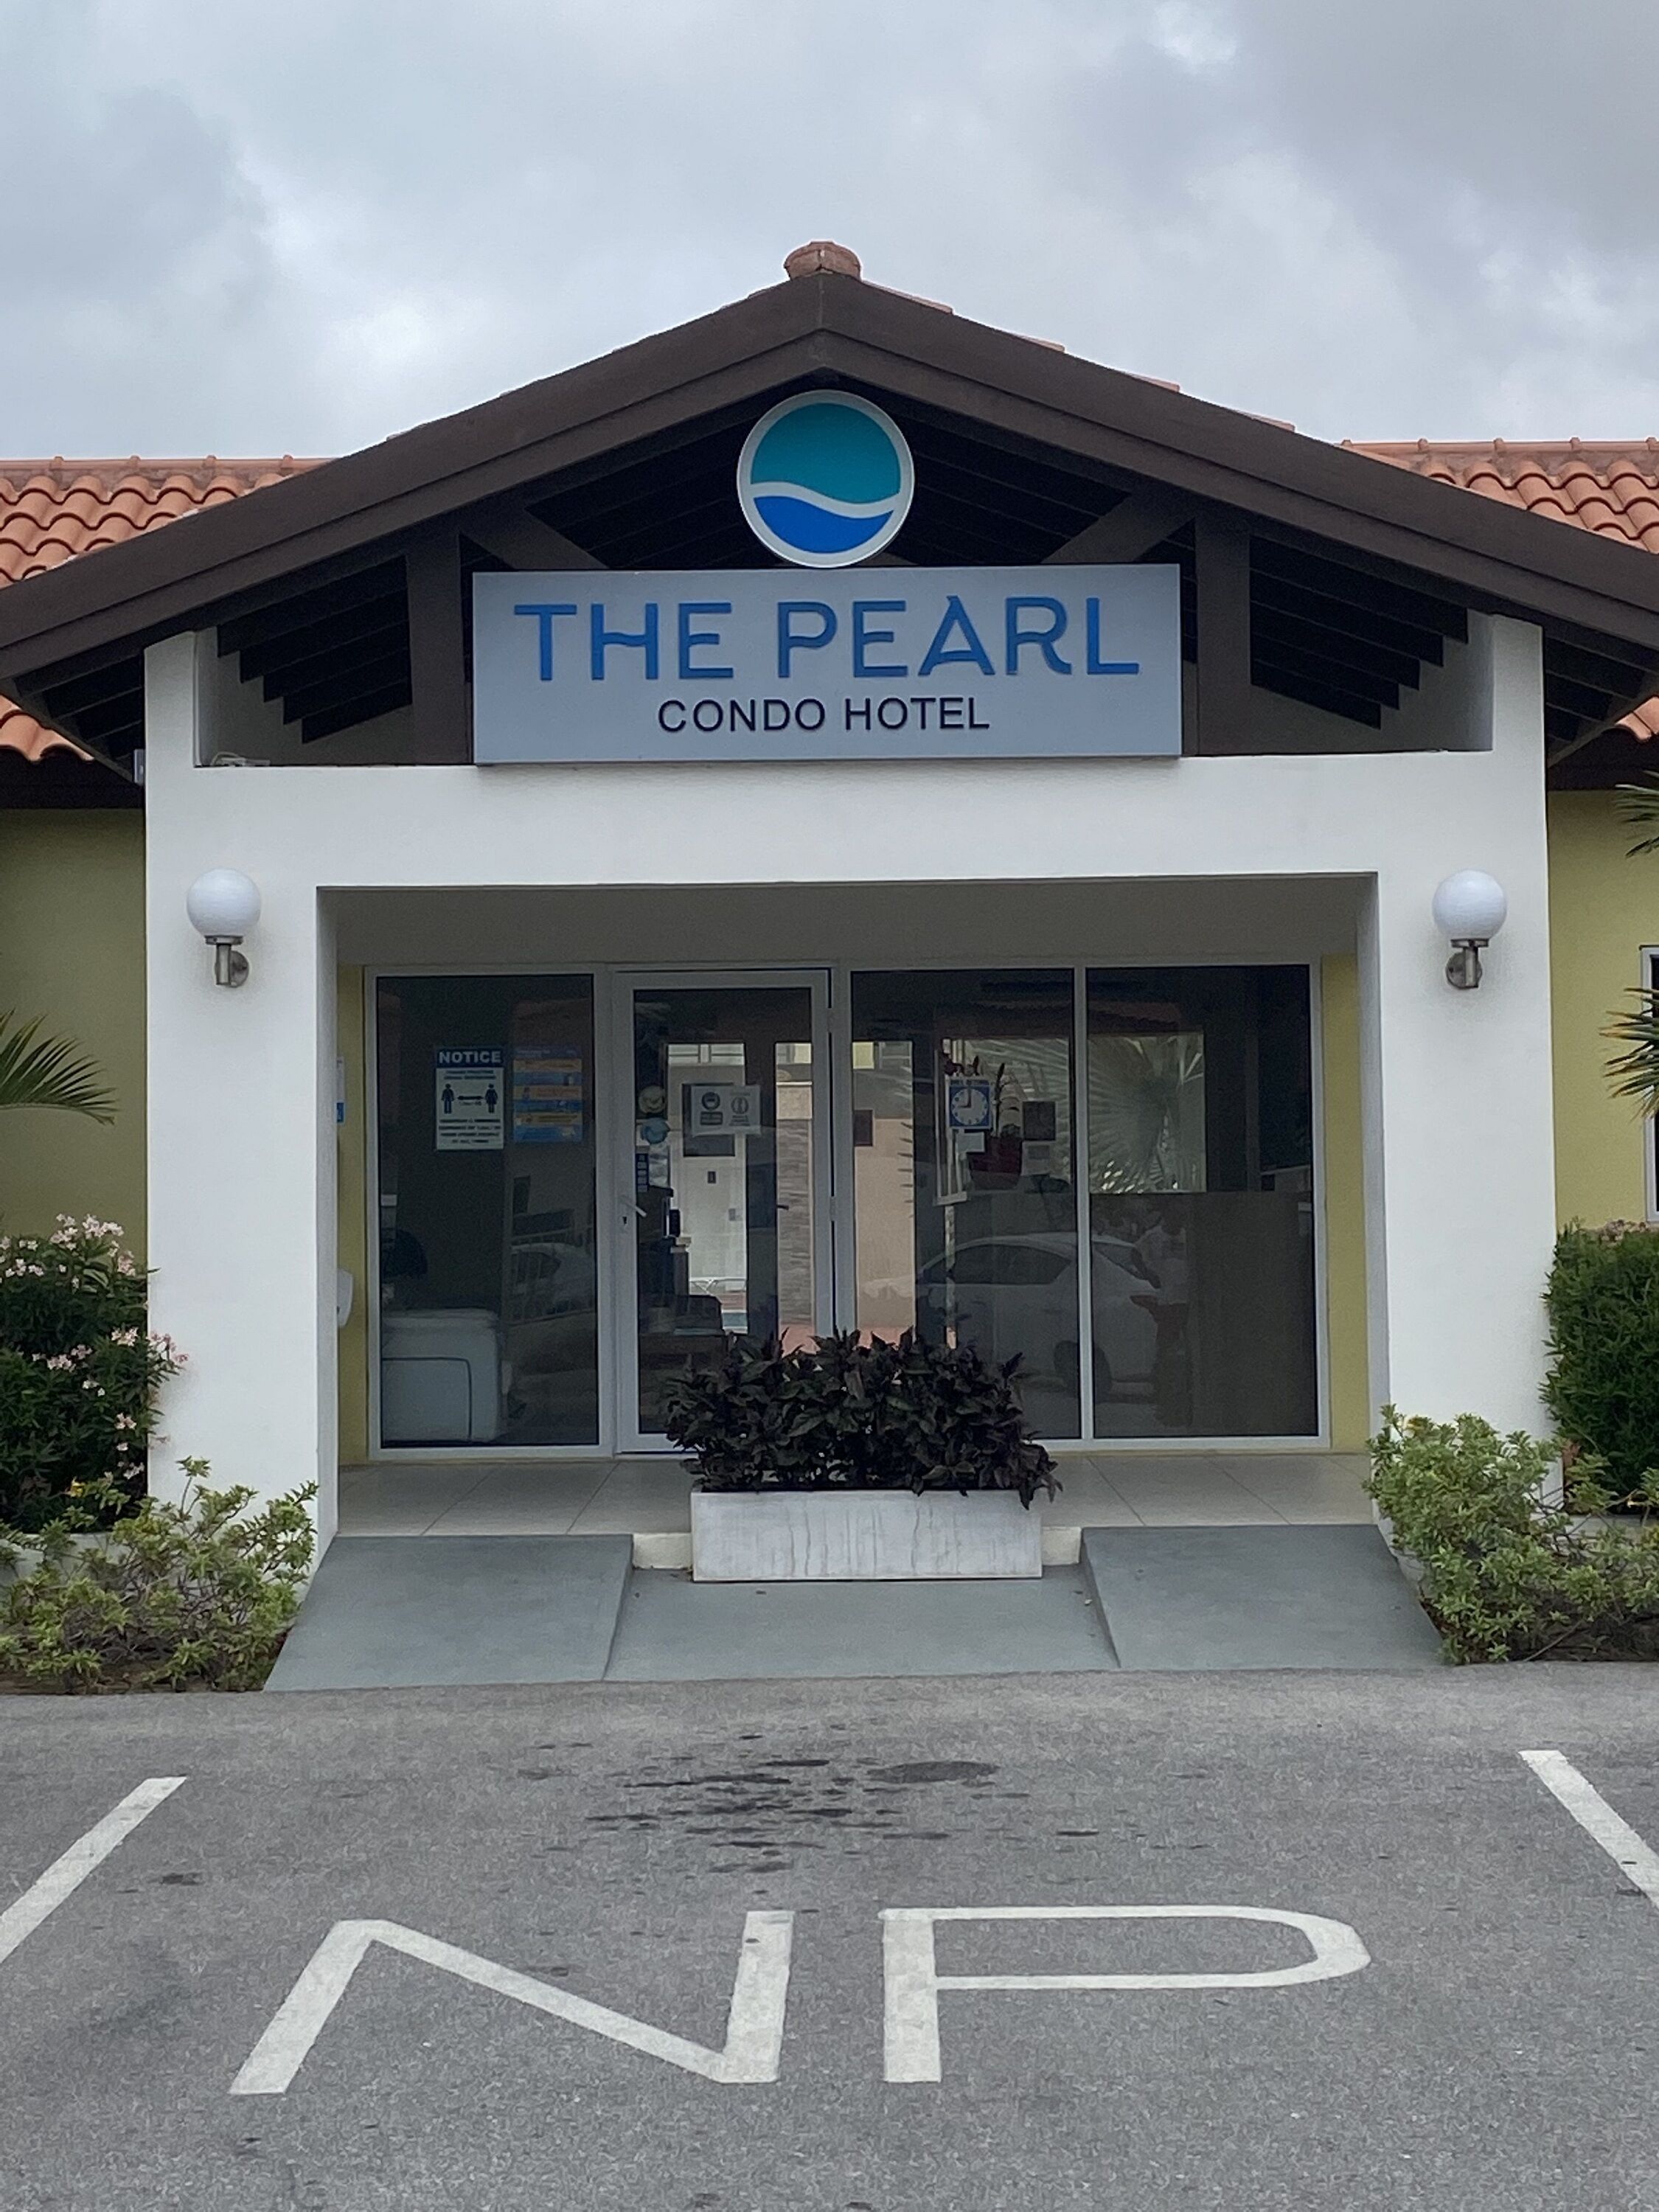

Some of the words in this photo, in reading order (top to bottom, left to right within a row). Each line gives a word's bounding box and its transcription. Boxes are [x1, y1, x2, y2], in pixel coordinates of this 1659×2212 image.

[514, 602, 734, 681] THE
[777, 595, 1140, 678] PEARL
[658, 699, 826, 732] CONDO
[844, 697, 990, 730] HOTEL
[439, 1051, 501, 1064] NOTICE
[229, 1905, 1371, 2095] NP
